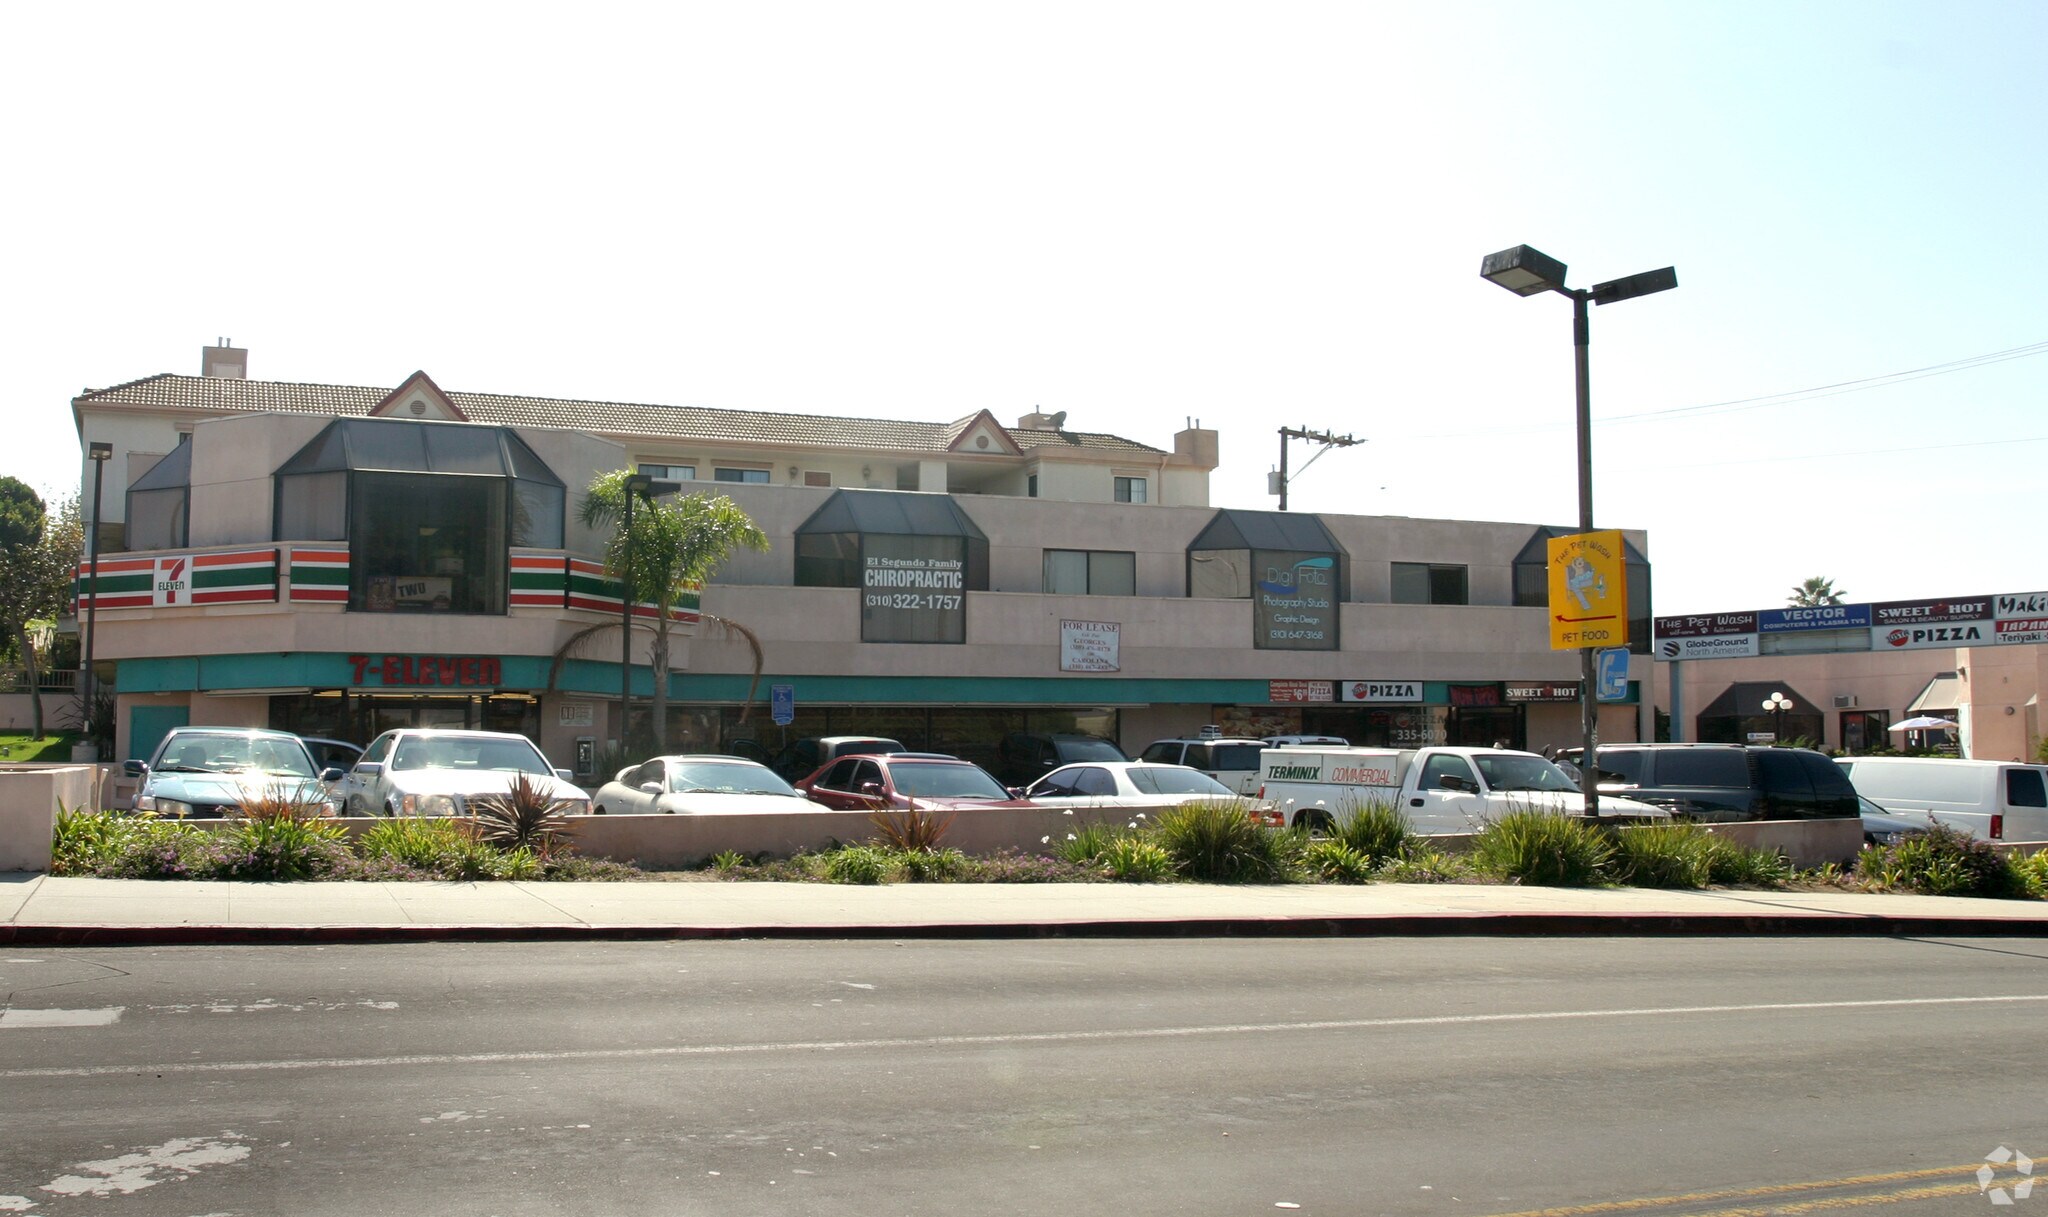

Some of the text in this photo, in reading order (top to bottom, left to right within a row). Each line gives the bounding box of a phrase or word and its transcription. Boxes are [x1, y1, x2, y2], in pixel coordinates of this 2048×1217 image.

[1570, 540, 1587, 551] PET
[866, 557, 962, 570] El Segundo Family
[161, 558, 186, 604] 7
[864, 569, 963, 589] CHIROPRACTIC
[1263, 594, 1330, 609] Photography Studio
[1782, 607, 1846, 621] VECTOR
[1878, 602, 1986, 619] SWEET HOT
[1273, 613, 1321, 626] Graphic Design
[1658, 619, 1683, 629] THE
[1687, 616, 1712, 628] PET
[1763, 621, 1809, 630] COMPUTERS
[1810, 619, 1817, 627] &
[1818, 618, 1850, 627] PLASMA
[1883, 613, 1981, 625] SALON & BEAUTY SUPPLY
[1063, 621, 1119, 633] FOR LEASE
[1562, 630, 1610, 643] PET FOOD
[1912, 626, 1981, 643] PIZZA
[1685, 637, 1749, 649] GlobeGround
[1685, 645, 1750, 657] North America
[1369, 685, 1415, 697] PIZZA
[1506, 687, 1544, 697] SWEET
[1553, 687, 1577, 697] HOT
[1397, 729, 1448, 741] 335-6070
[1268, 765, 1391, 784] TERMINIX COMMERCIAL
